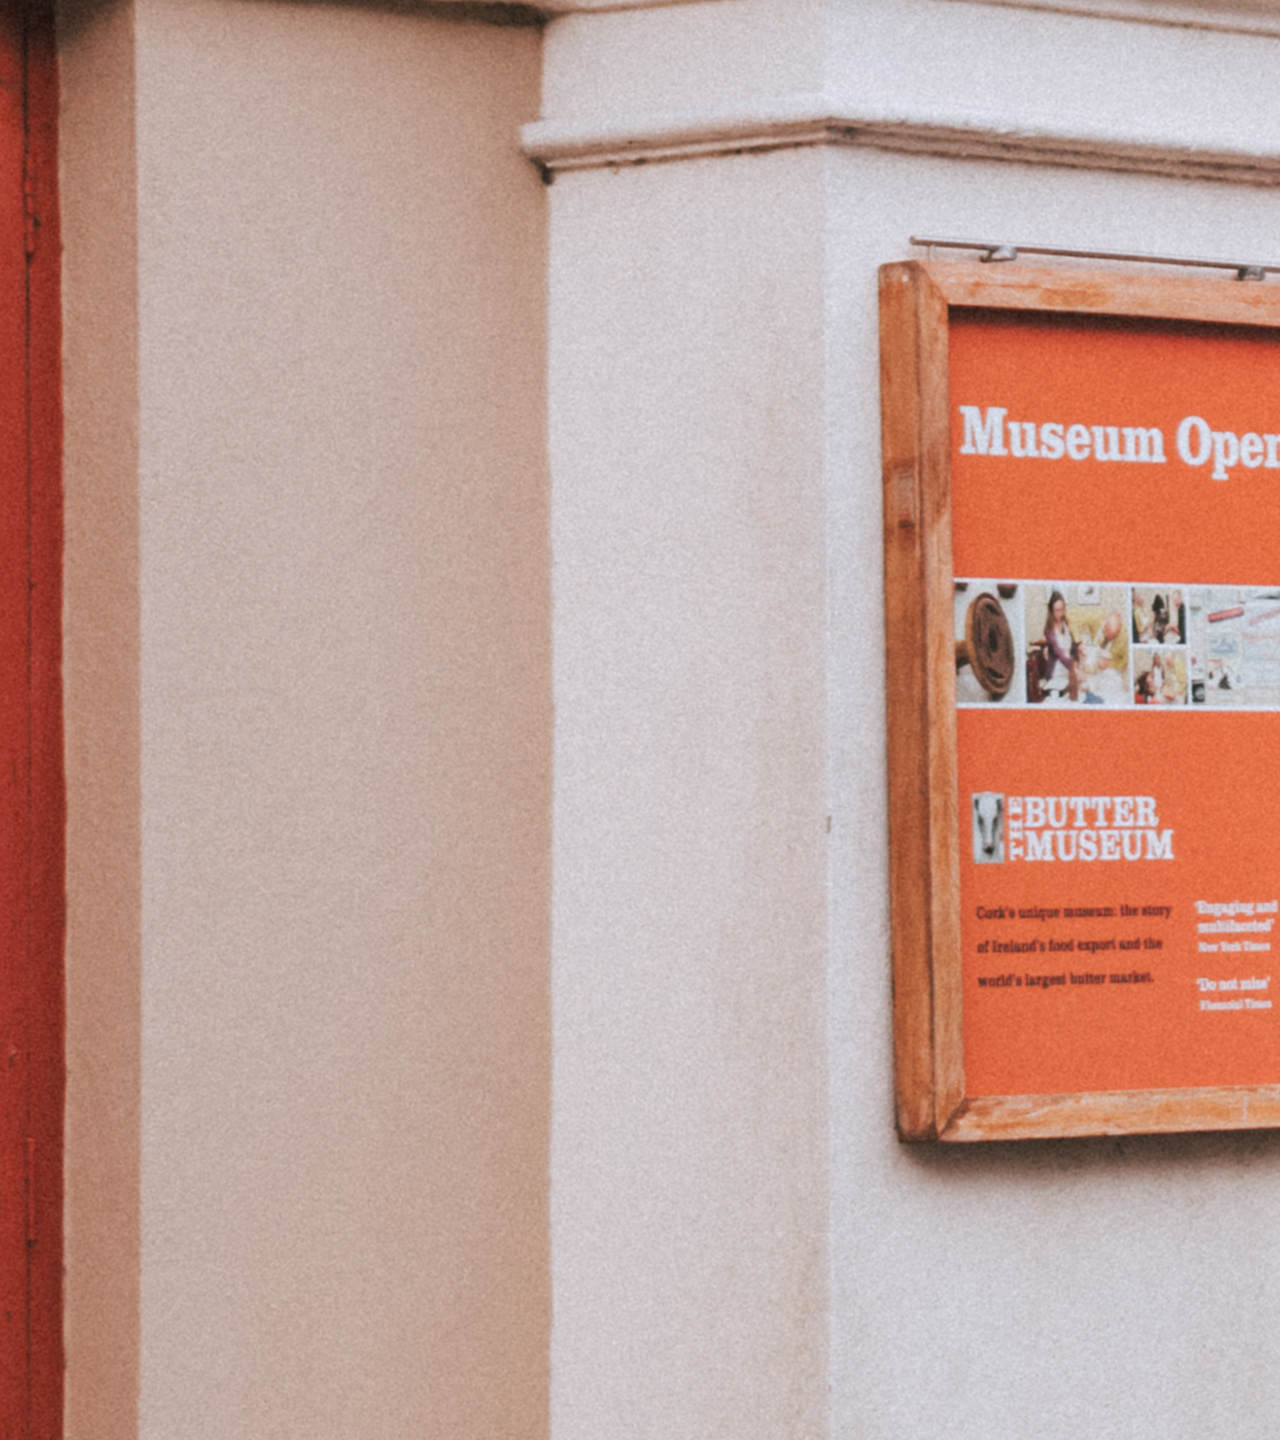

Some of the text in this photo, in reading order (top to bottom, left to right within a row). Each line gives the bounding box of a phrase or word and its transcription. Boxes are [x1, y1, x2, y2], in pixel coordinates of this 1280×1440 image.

[959, 405, 1167, 463] Museum
[1023, 796, 1159, 827] BUTTER
[1008, 796, 1023, 861] THE
[1024, 829, 1175, 861] MUSEUM
[976, 906, 1015, 919] Cork's
[1018, 906, 1060, 921] unique
[1120, 904, 1139, 917] the
[1142, 905, 1172, 919] story
[976, 937, 1162, 953] of Ireland's food export and the
[977, 973, 1022, 987] world's
[1025, 973, 1066, 989] largest
[1070, 972, 1107, 985] butter
[1218, 977, 1238, 991] not
